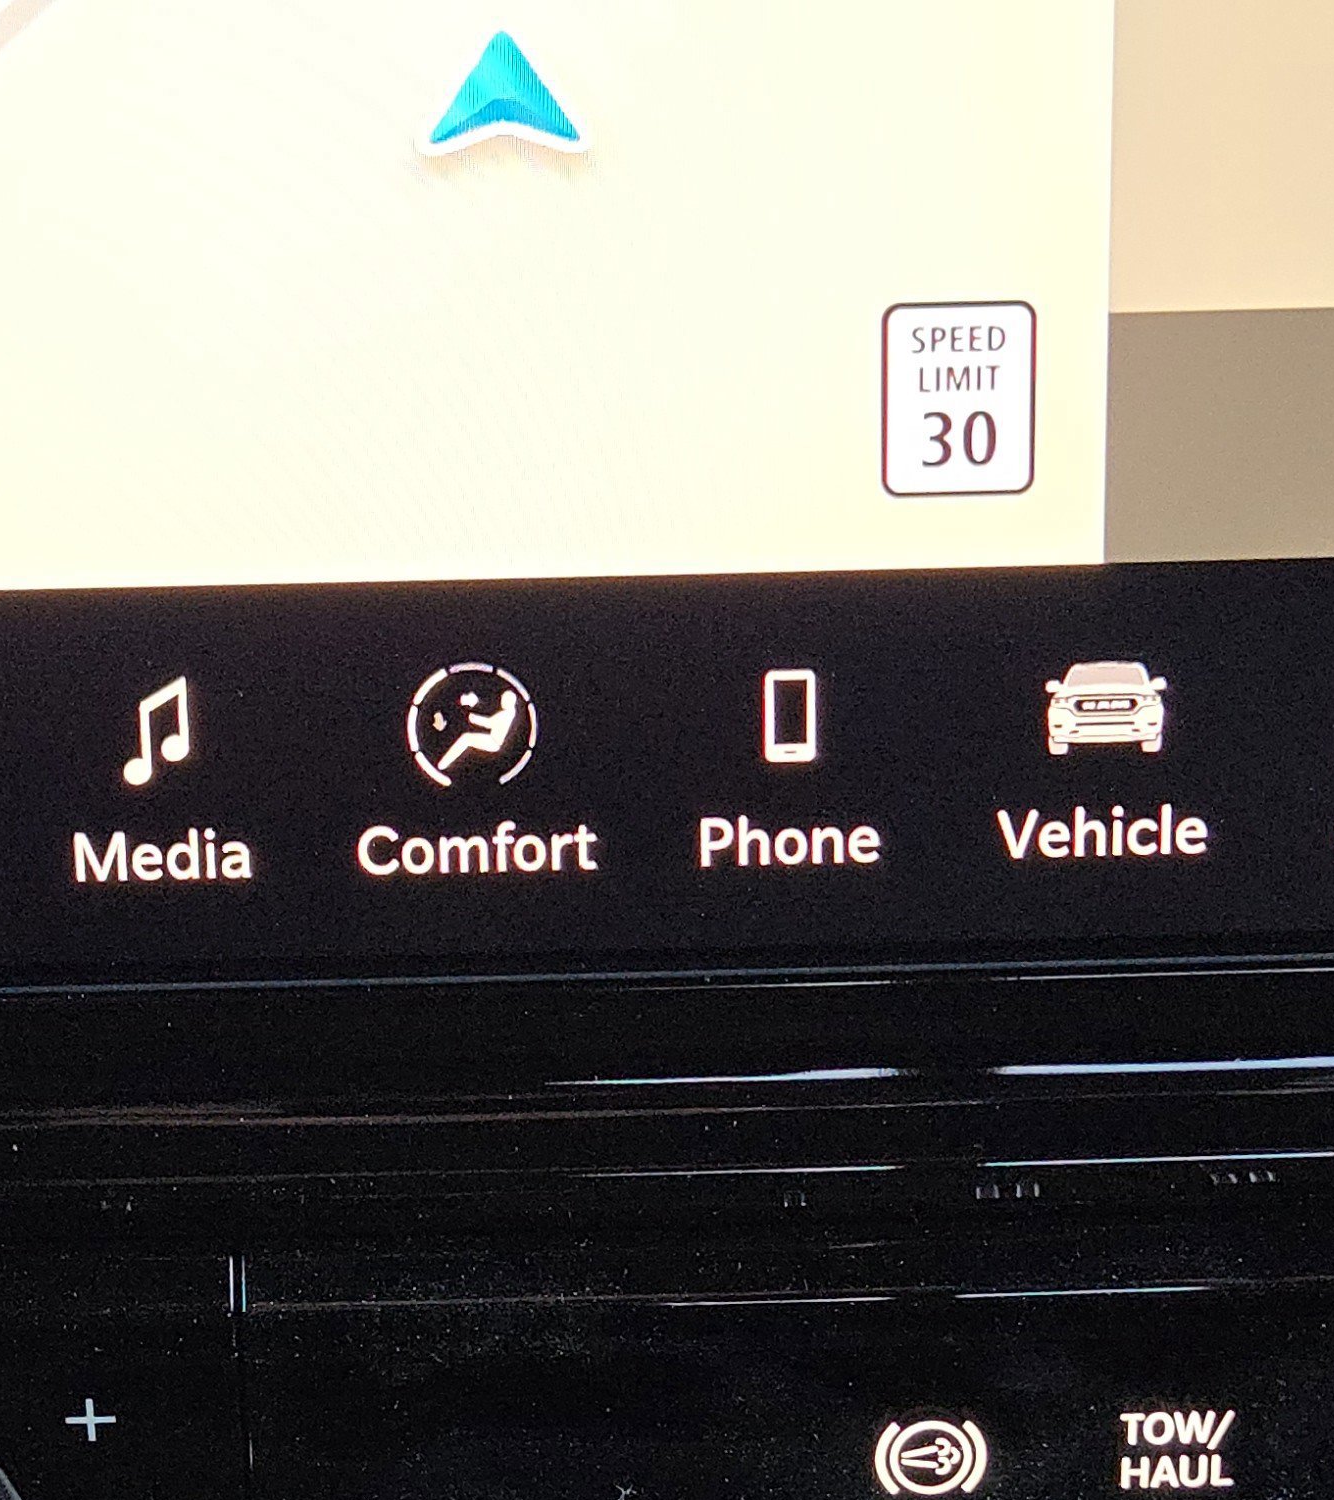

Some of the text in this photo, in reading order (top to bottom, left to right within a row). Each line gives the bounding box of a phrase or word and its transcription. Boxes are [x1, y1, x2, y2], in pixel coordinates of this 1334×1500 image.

[912, 326, 1005, 353] SPEED
[919, 365, 998, 392] LIMIT
[923, 411, 996, 467] 30
[74, 828, 252, 882] Media
[358, 821, 598, 875] Comfort
[700, 815, 881, 867] Phone
[997, 804, 1208, 859] Vehicle
[1120, 1410, 1235, 1450] TOW/
[1120, 1454, 1234, 1489] HAUL
